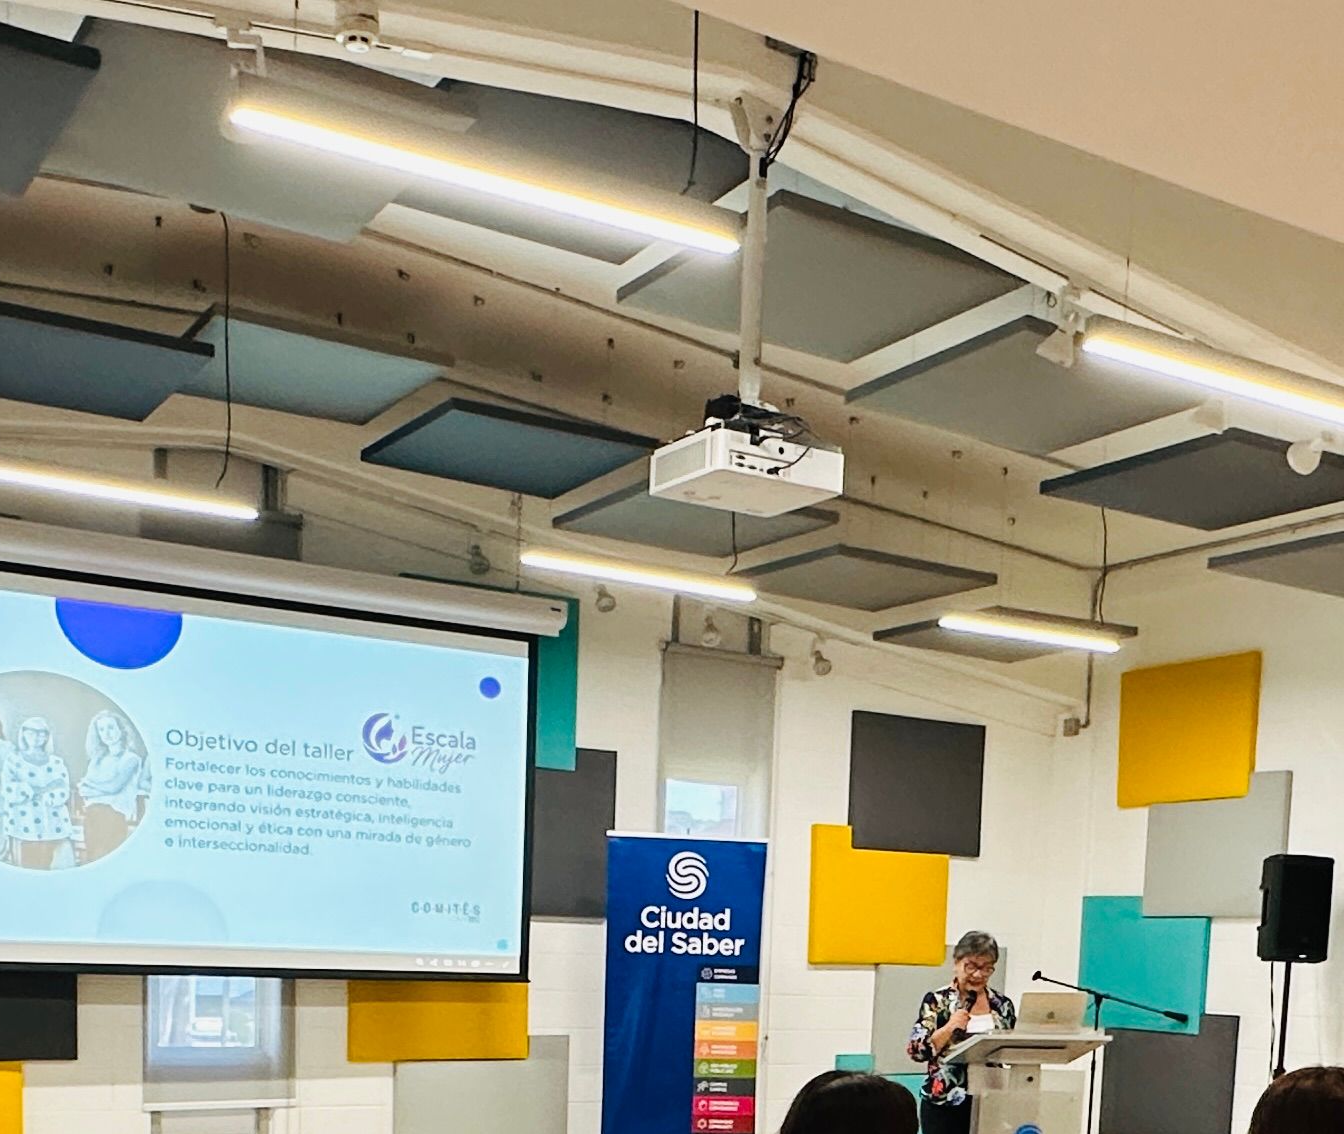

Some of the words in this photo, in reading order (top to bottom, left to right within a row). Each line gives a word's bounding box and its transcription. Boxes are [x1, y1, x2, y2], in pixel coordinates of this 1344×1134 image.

[166, 729, 258, 753] Objetivo
[265, 739, 296, 756] del
[303, 742, 354, 762] taller
[411, 726, 476, 750] Escala
[411, 747, 475, 774] Mujer
[165, 757, 241, 775] Fortalecer
[246, 764, 266, 777] los
[270, 768, 371, 787] conocimientos
[375, 778, 384, 789] y
[387, 777, 462, 794] habilidades
[164, 778, 204, 791] clave
[208, 783, 240, 794] para
[245, 786, 263, 795] un
[267, 784, 332, 801] liderazgo
[164, 796, 246, 812] integrando
[249, 803, 292, 817] visión
[378, 813, 454, 829] inteligencia
[164, 817, 242, 832] emocional
[245, 823, 254, 835] y
[258, 821, 293, 836] ética
[296, 826, 322, 838] con
[326, 828, 352, 840] una
[355, 830, 402, 843] mirada
[405, 832, 423, 845] de
[425, 834, 472, 848] género
[164, 836, 174, 848] e
[640, 905, 731, 931] Ciudad
[624, 930, 665, 954] del
[671, 931, 745, 956] Saber
